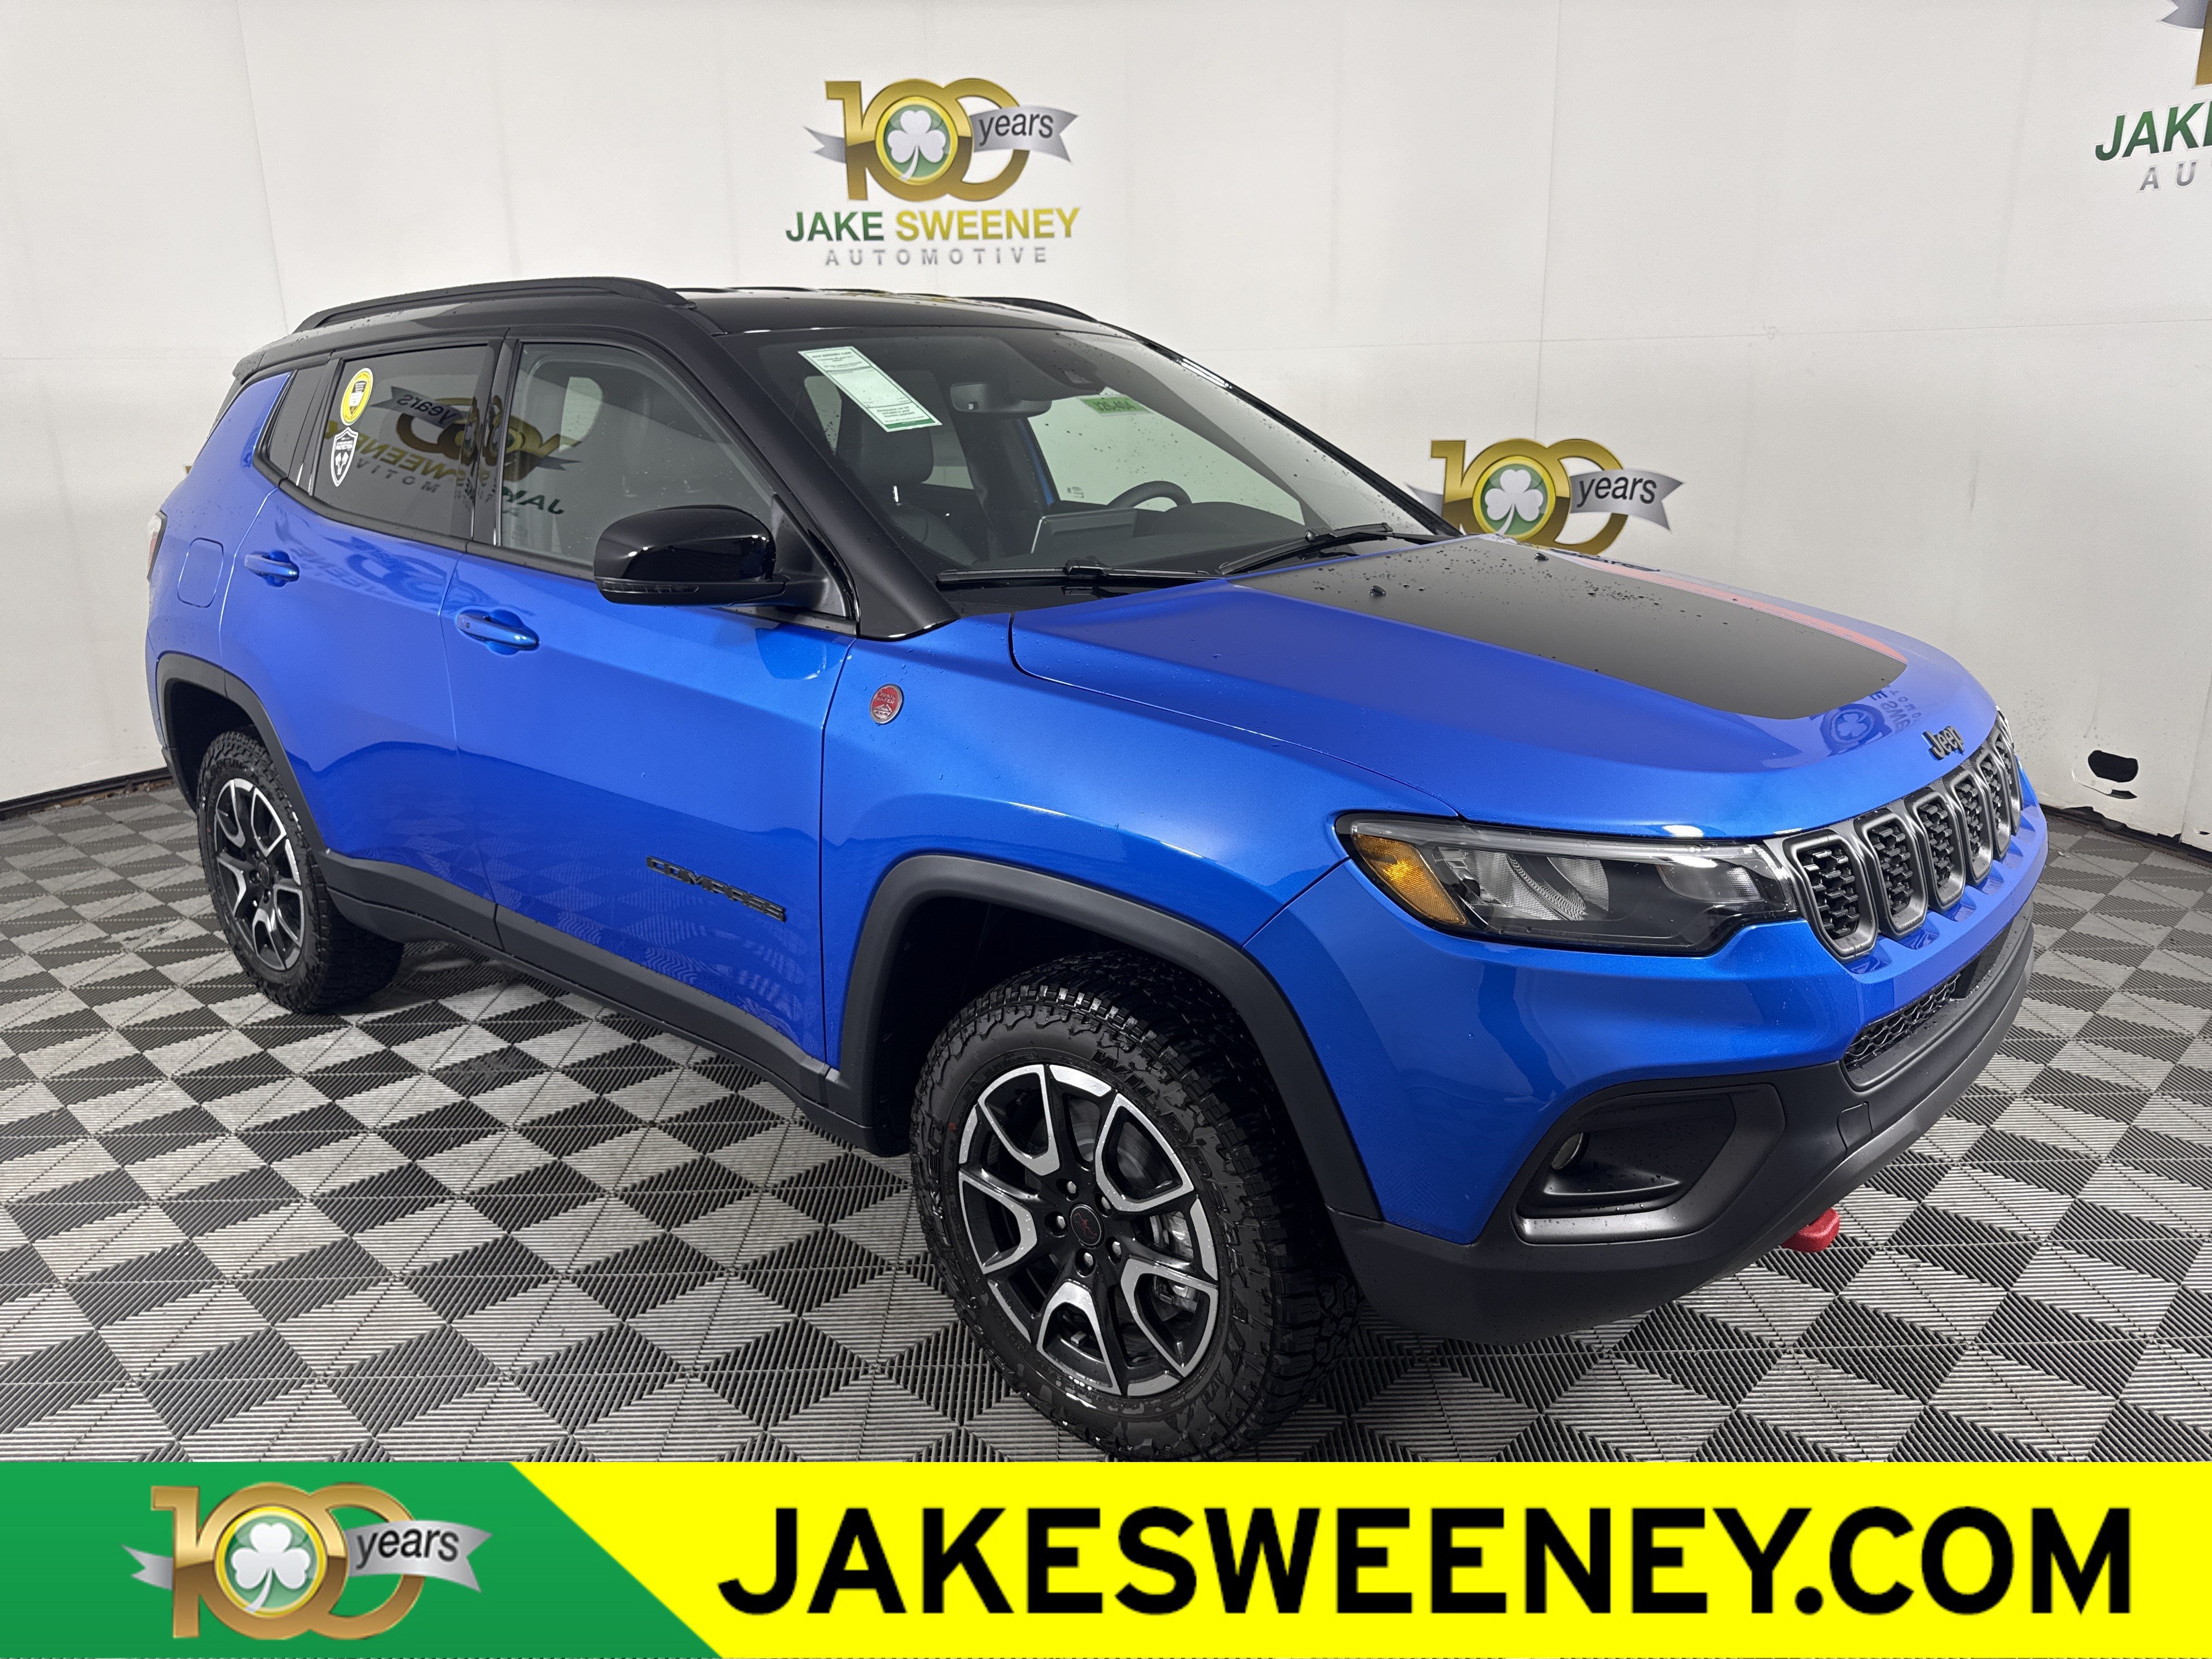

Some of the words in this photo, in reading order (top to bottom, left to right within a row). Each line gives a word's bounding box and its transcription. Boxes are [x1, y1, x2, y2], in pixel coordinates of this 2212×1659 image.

[825, 78, 1030, 201] 100
[979, 111, 1054, 146] years
[785, 211, 884, 242] JAKE
[895, 207, 1080, 241] SWEENEY
[826, 246, 1047, 266] AUTOMOTIVE
[1431, 438, 1628, 555] 100
[1576, 476, 1657, 508] years
[1921, 726, 1965, 761] Jeep
[646, 855, 786, 922] COMPASS
